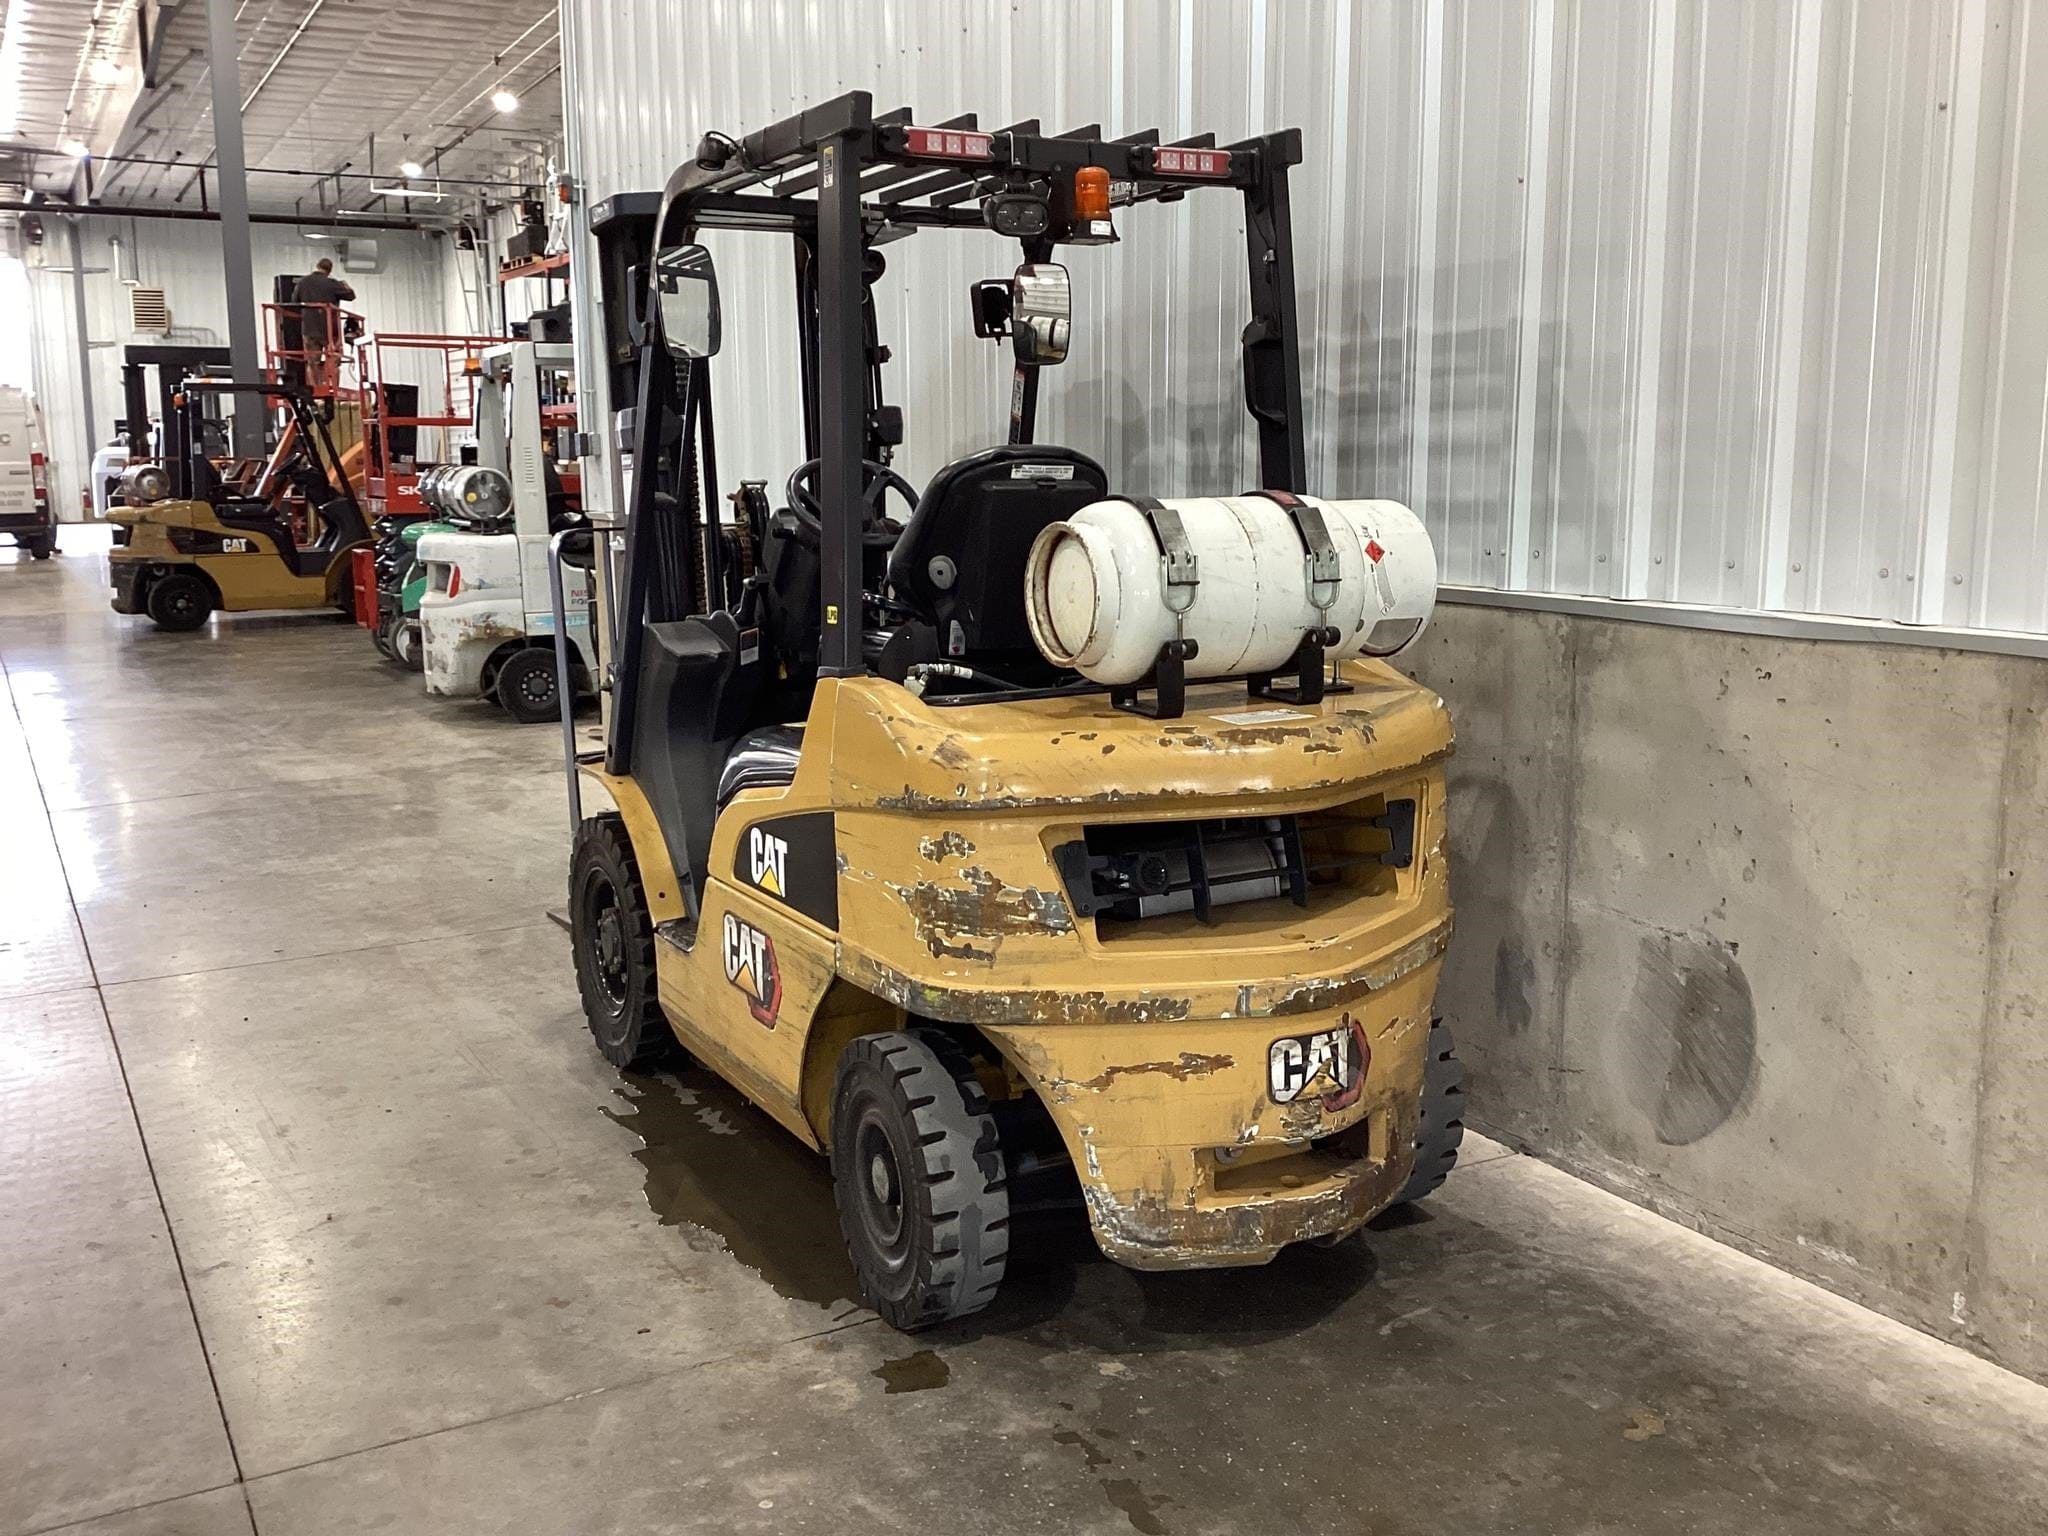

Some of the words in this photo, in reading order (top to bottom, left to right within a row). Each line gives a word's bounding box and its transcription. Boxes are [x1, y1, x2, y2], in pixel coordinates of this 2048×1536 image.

[223, 539, 247, 552] CAT
[750, 827, 788, 898] CAT
[724, 914, 766, 1002] CAT
[1271, 1028, 1354, 1102] CAT
